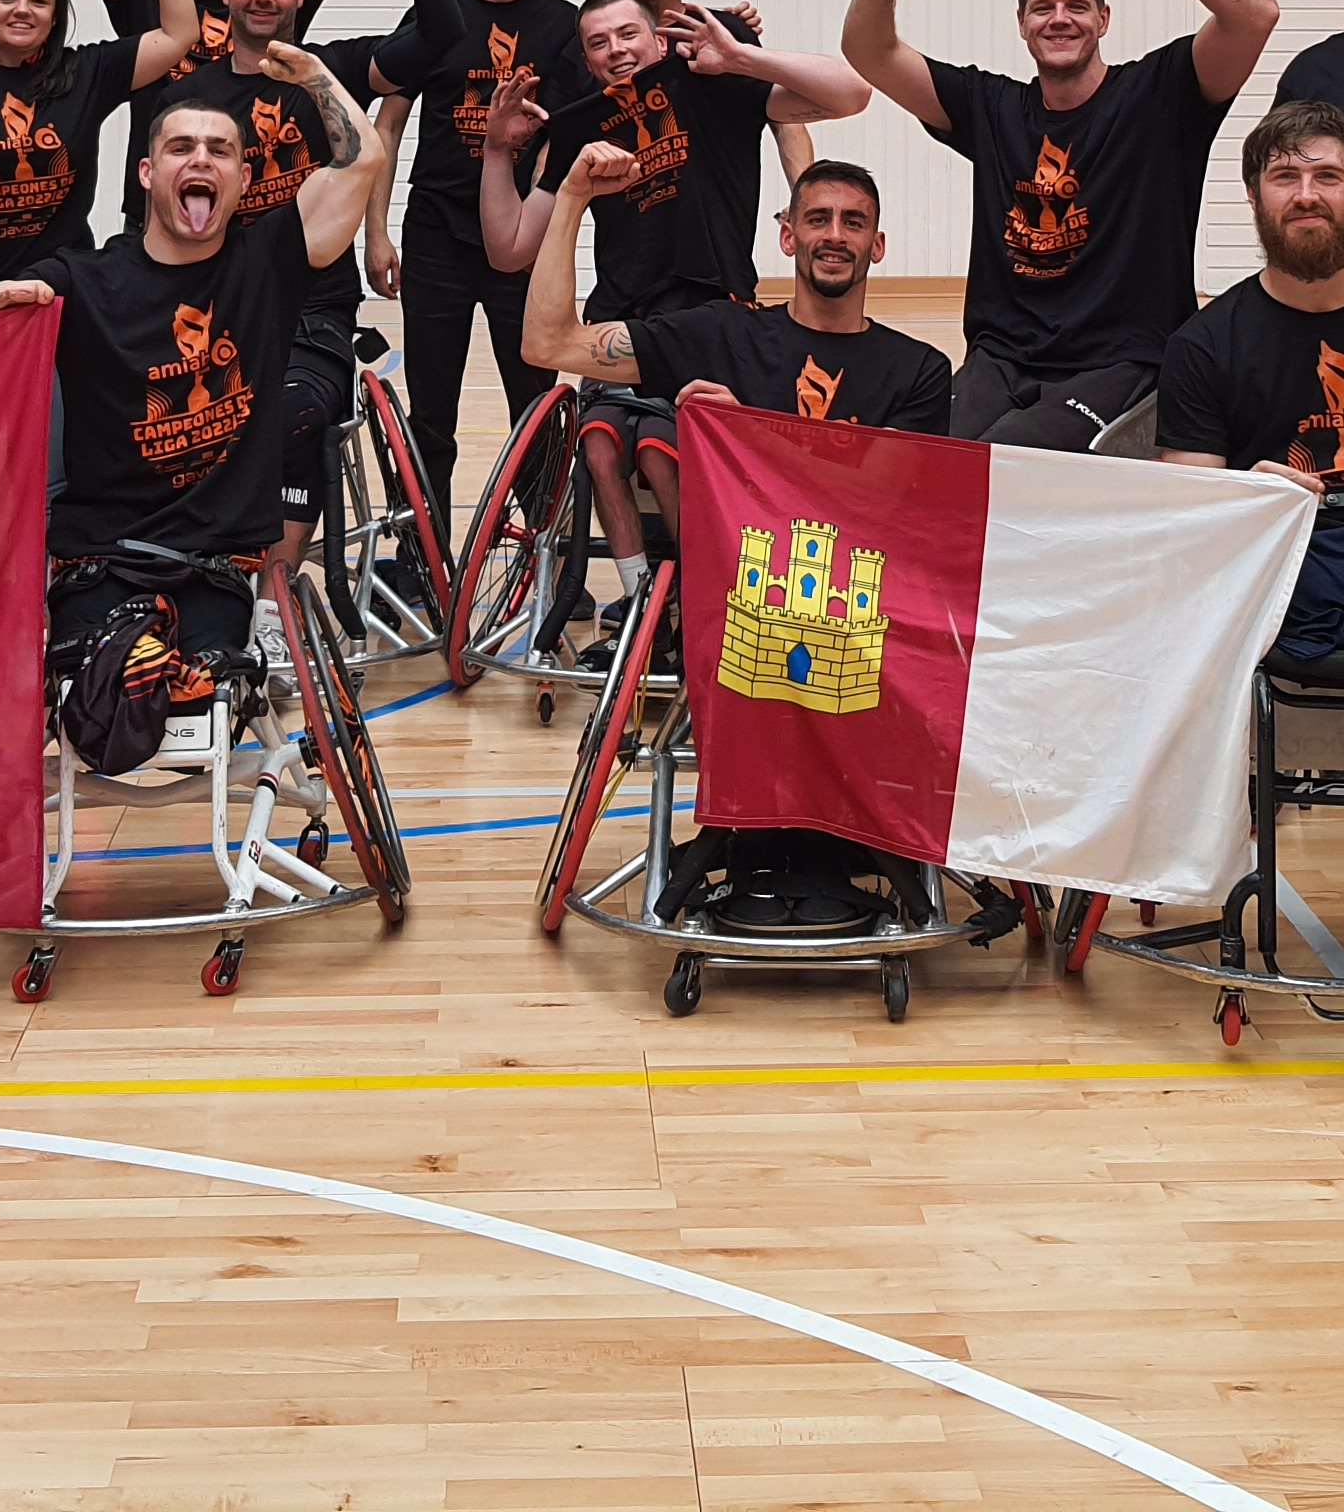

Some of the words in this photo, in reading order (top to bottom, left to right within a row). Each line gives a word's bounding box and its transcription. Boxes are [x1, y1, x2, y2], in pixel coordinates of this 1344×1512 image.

[468, 66, 513, 79] amiab
[600, 100, 645, 131] amiab
[673, 136, 689, 147] DE
[1068, 213, 1089, 229] DE
[134, 400, 234, 441] CAMPEONES
[141, 435, 188, 457] LIGA
[287, 487, 308, 504] NBA
